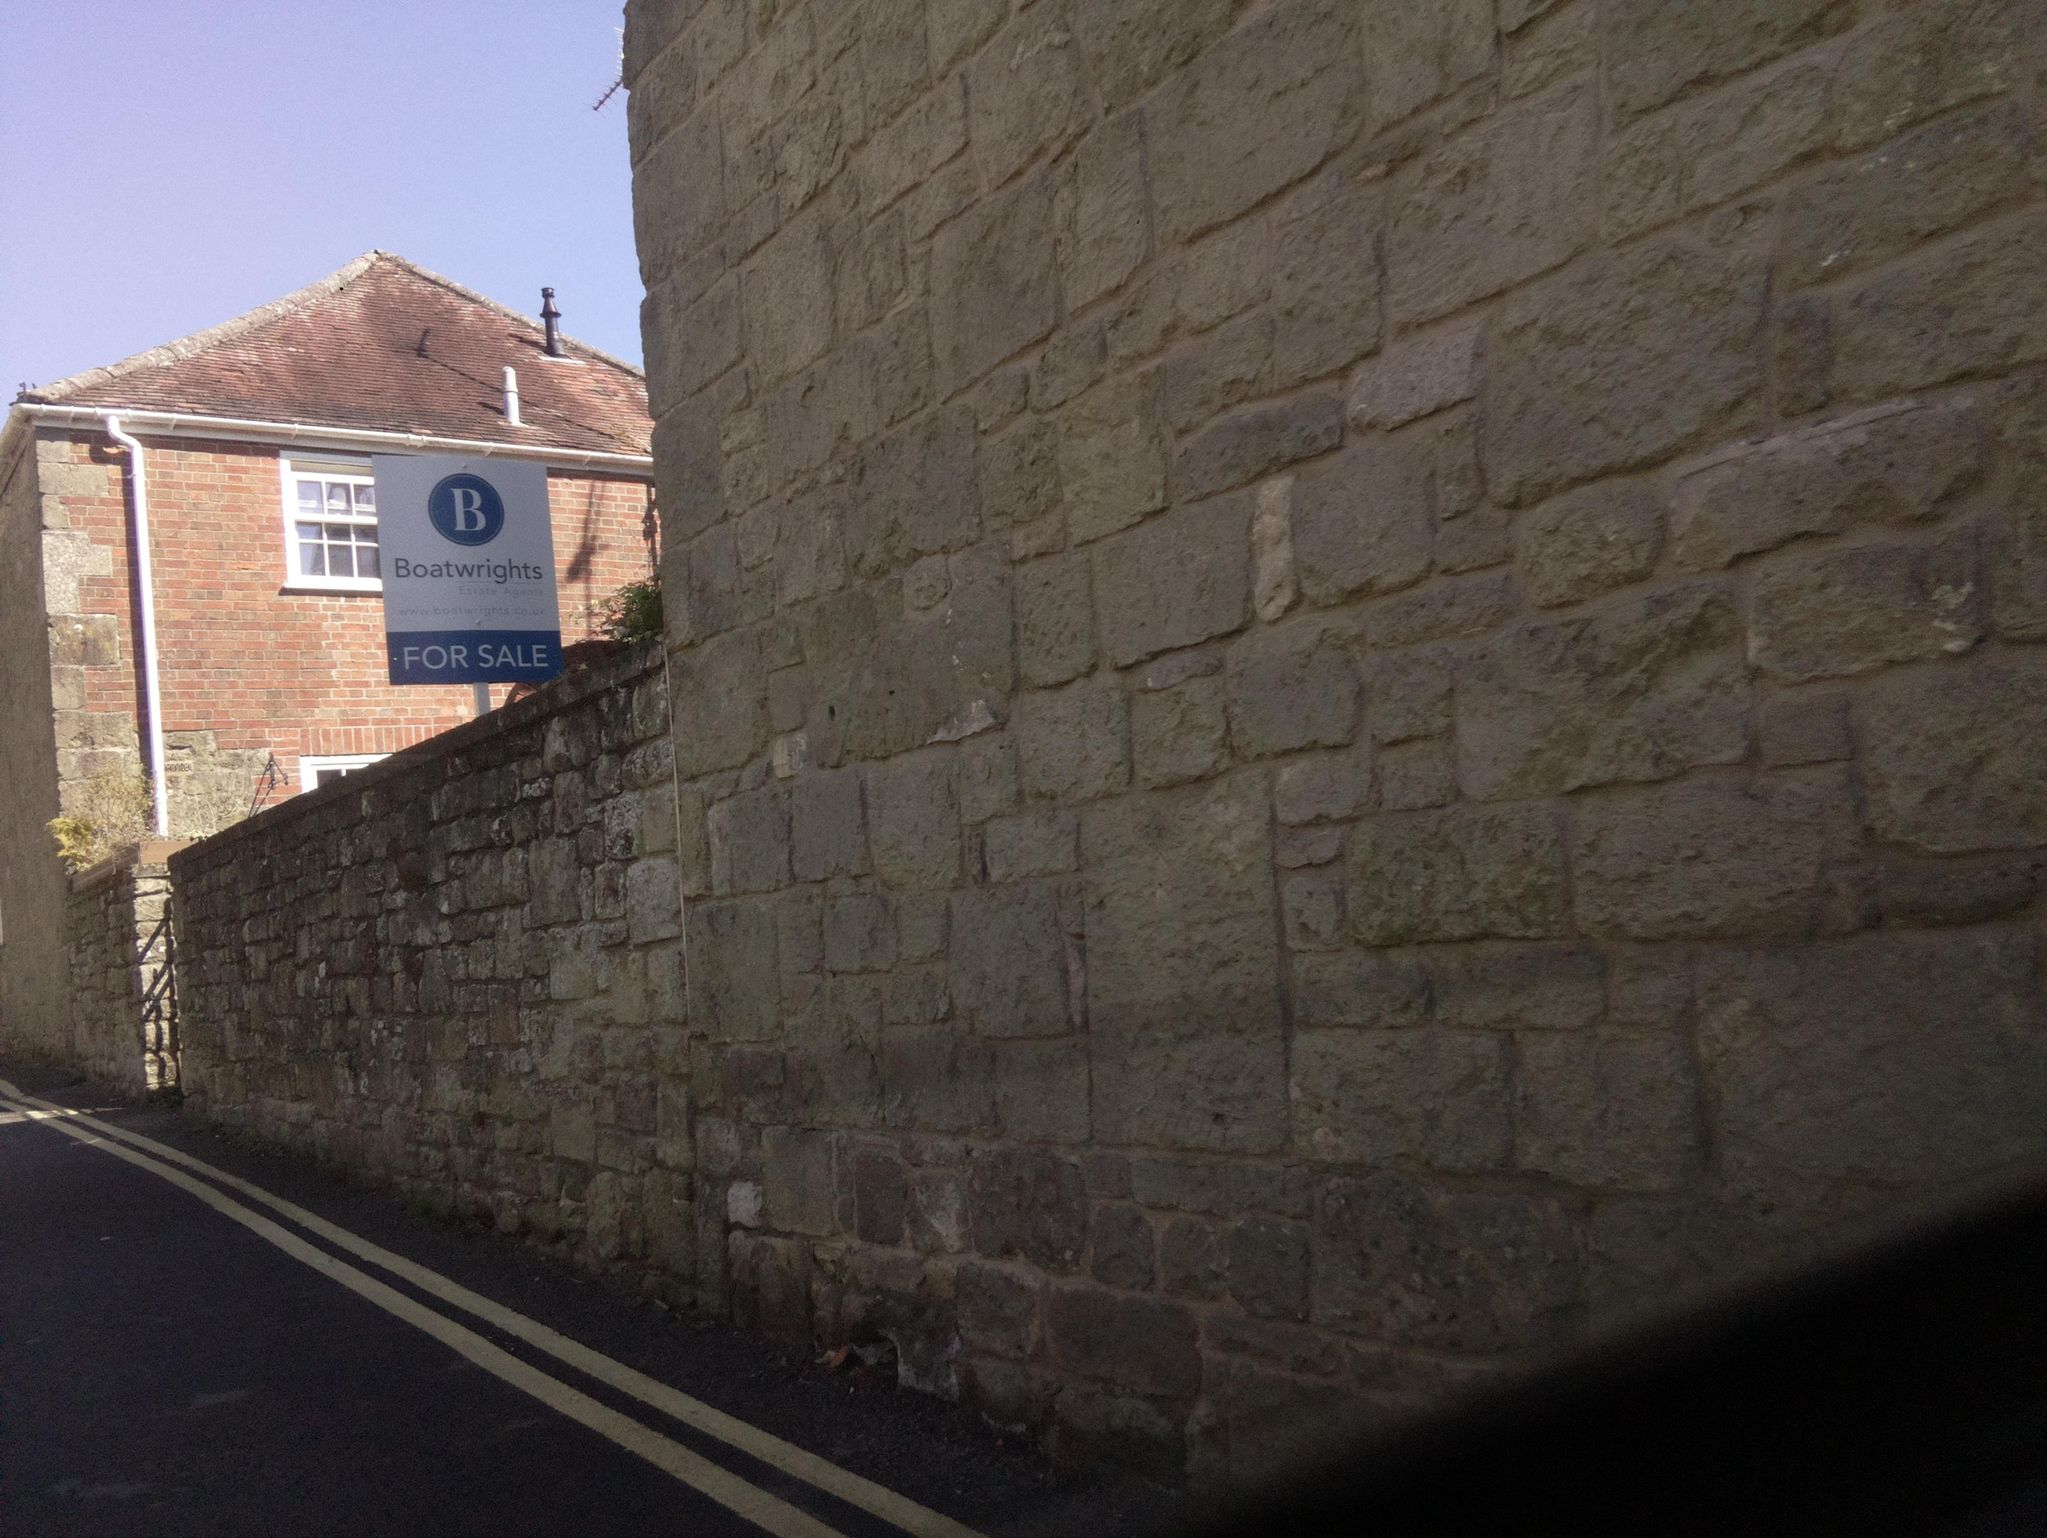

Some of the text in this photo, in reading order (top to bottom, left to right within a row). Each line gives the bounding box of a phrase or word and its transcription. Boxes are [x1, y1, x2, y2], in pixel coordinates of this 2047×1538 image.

[451, 488, 486, 531] B
[394, 558, 543, 584] Boatwrights
[458, 586, 544, 599] Estate Agents
[403, 644, 549, 670] FOR SALE
